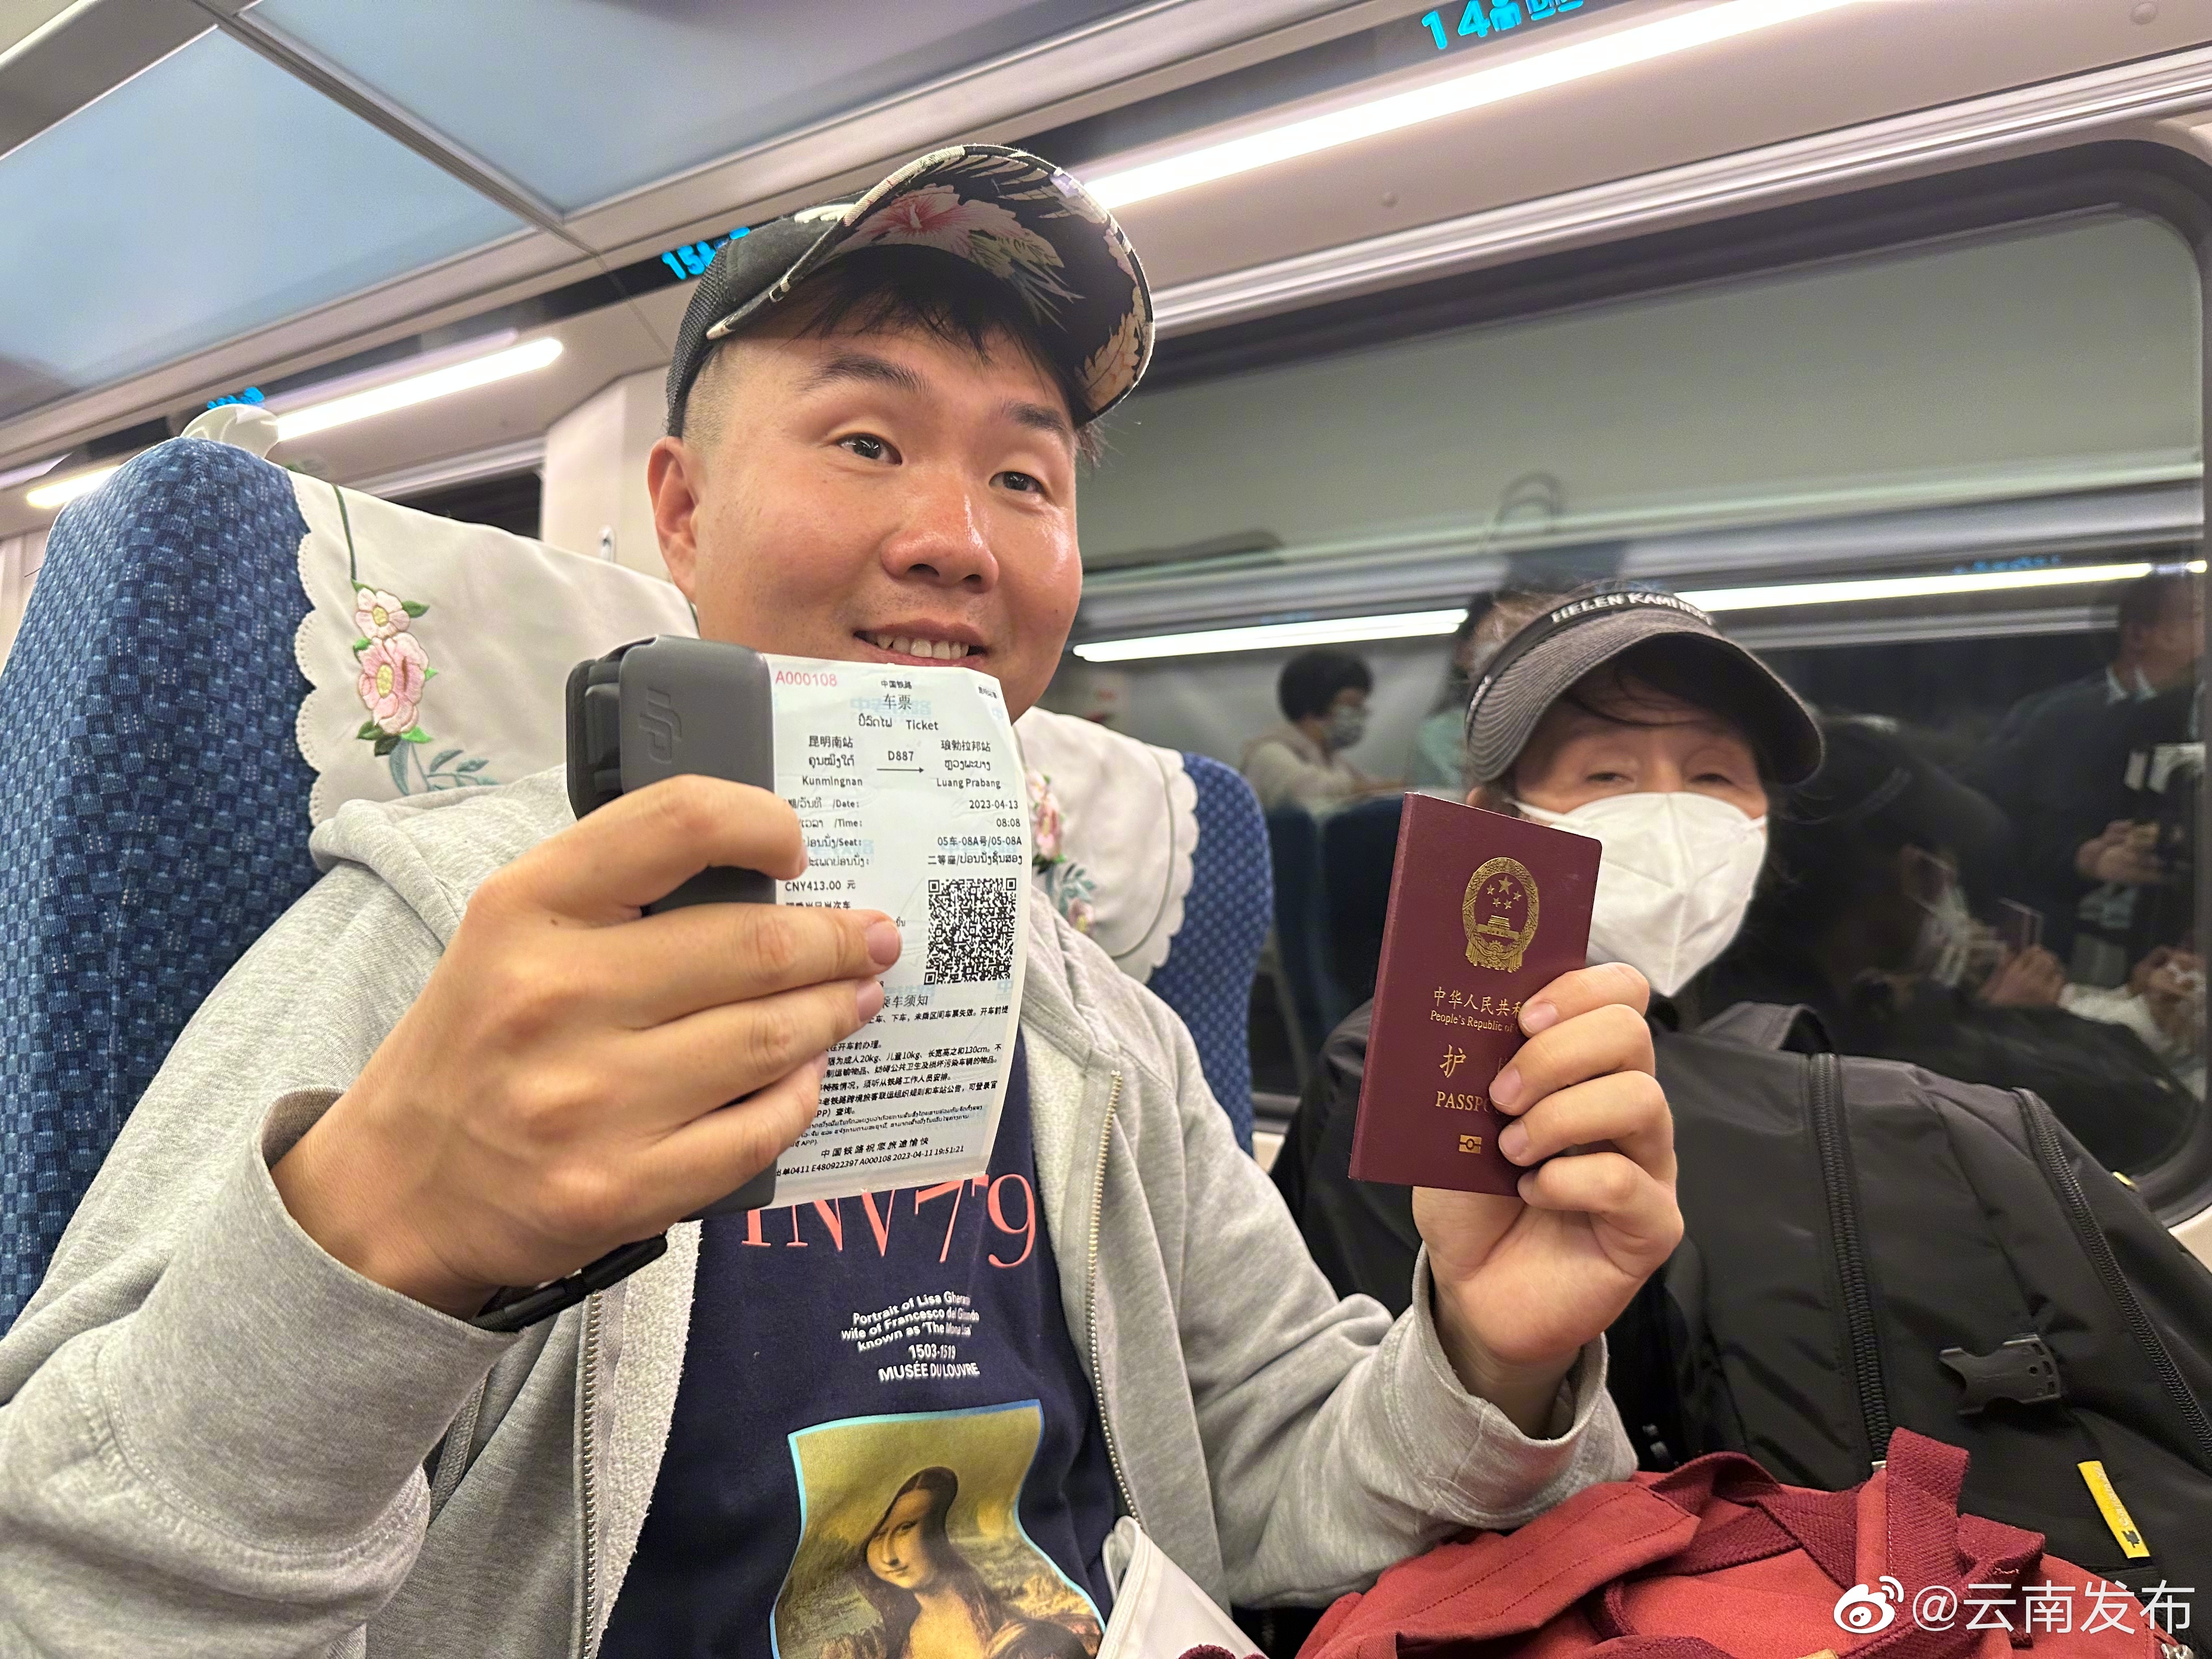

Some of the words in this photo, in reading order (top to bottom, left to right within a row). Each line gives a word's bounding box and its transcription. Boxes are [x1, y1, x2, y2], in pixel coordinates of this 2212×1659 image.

[1421, 0, 1490, 49] 14
[775, 670, 838, 686] A000108
[883, 693, 912, 710] 车票
[906, 719, 939, 731] Ticket
[809, 735, 854, 748] 昆明南站
[941, 740, 991, 752] 琅勃拉邦站
[888, 751, 914, 761] D887
[803, 776, 863, 787] Kunmingnan
[936, 778, 963, 789] Luang
[966, 778, 1001, 789] Prabang
[833, 799, 860, 809] /Date:
[969, 800, 1019, 809] 2023-04-13
[834, 819, 862, 828] /Time:
[996, 818, 1020, 827] 08:08
[938, 836, 1022, 847] 05车-08A号/05-08A
[785, 880, 841, 892] CNY413.00
[847, 879, 856, 889] 元
[1430, 1009, 1465, 1025] People's
[1466, 1016, 1503, 1031] Republic
[1504, 1023, 1515, 1033] of
[1440, 1044, 1466, 1078] 护
[811, 1159, 859, 1172] E480922397
[859, 1154, 891, 1165] A000108
[893, 1147, 933, 1161] 2023-04-11
[934, 1145, 964, 1155] 19:51:21
[853, 1305, 899, 1325] Portrait
[901, 1297, 915, 1311] of
[916, 1294, 942, 1308] Lisa
[841, 1327, 866, 1341] wife
[868, 1322, 882, 1337] of
[883, 1308, 945, 1331] Francesco
[857, 1330, 903, 1353] known
[906, 1325, 921, 1338] as
[878, 1361, 929, 1381] MUSÉE
[943, 1362, 980, 1379] LOUVRE
